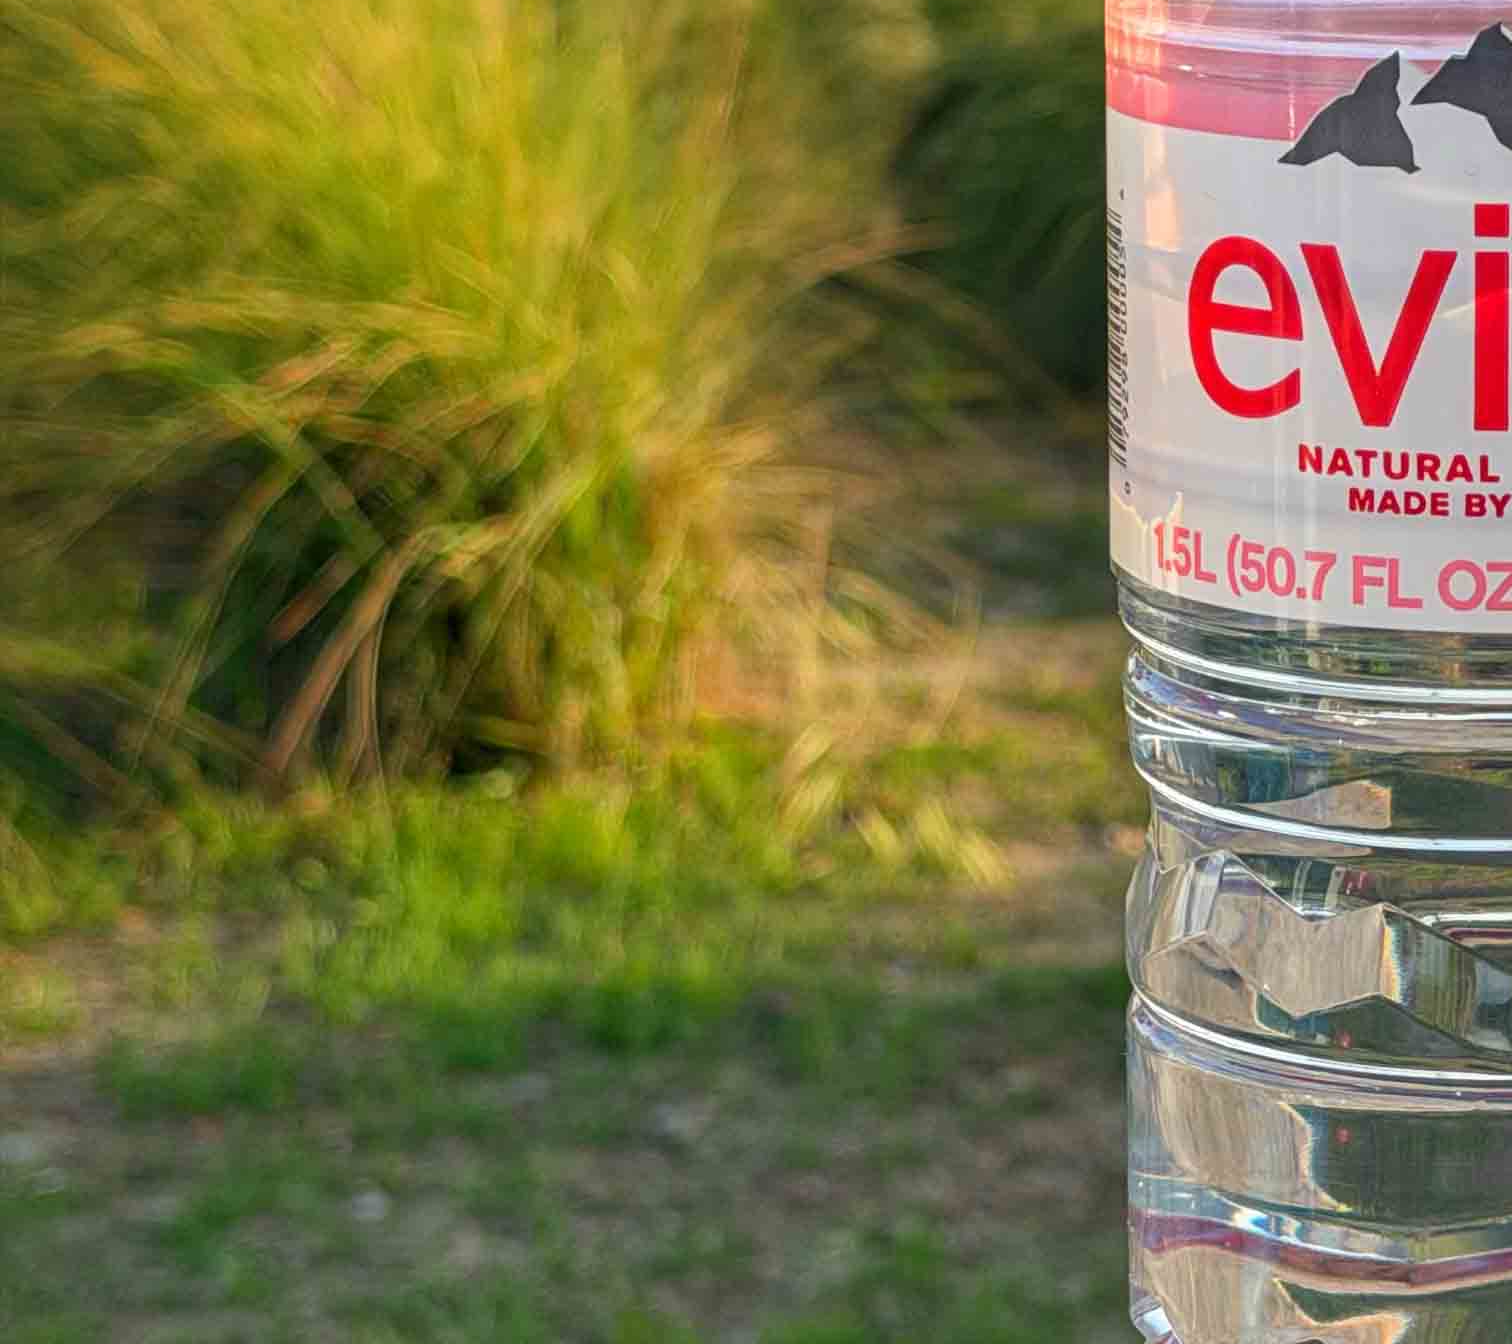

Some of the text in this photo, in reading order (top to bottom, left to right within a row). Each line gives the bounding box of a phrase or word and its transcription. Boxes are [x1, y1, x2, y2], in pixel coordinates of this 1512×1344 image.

[1298, 443, 1499, 482] NATURAL
[1348, 487, 1449, 517] MADE
[1464, 493, 1510, 518] BY
[1153, 521, 1216, 584] 1.5L
[1226, 533, 1337, 601] (50.7
[1350, 554, 1424, 609] FL
